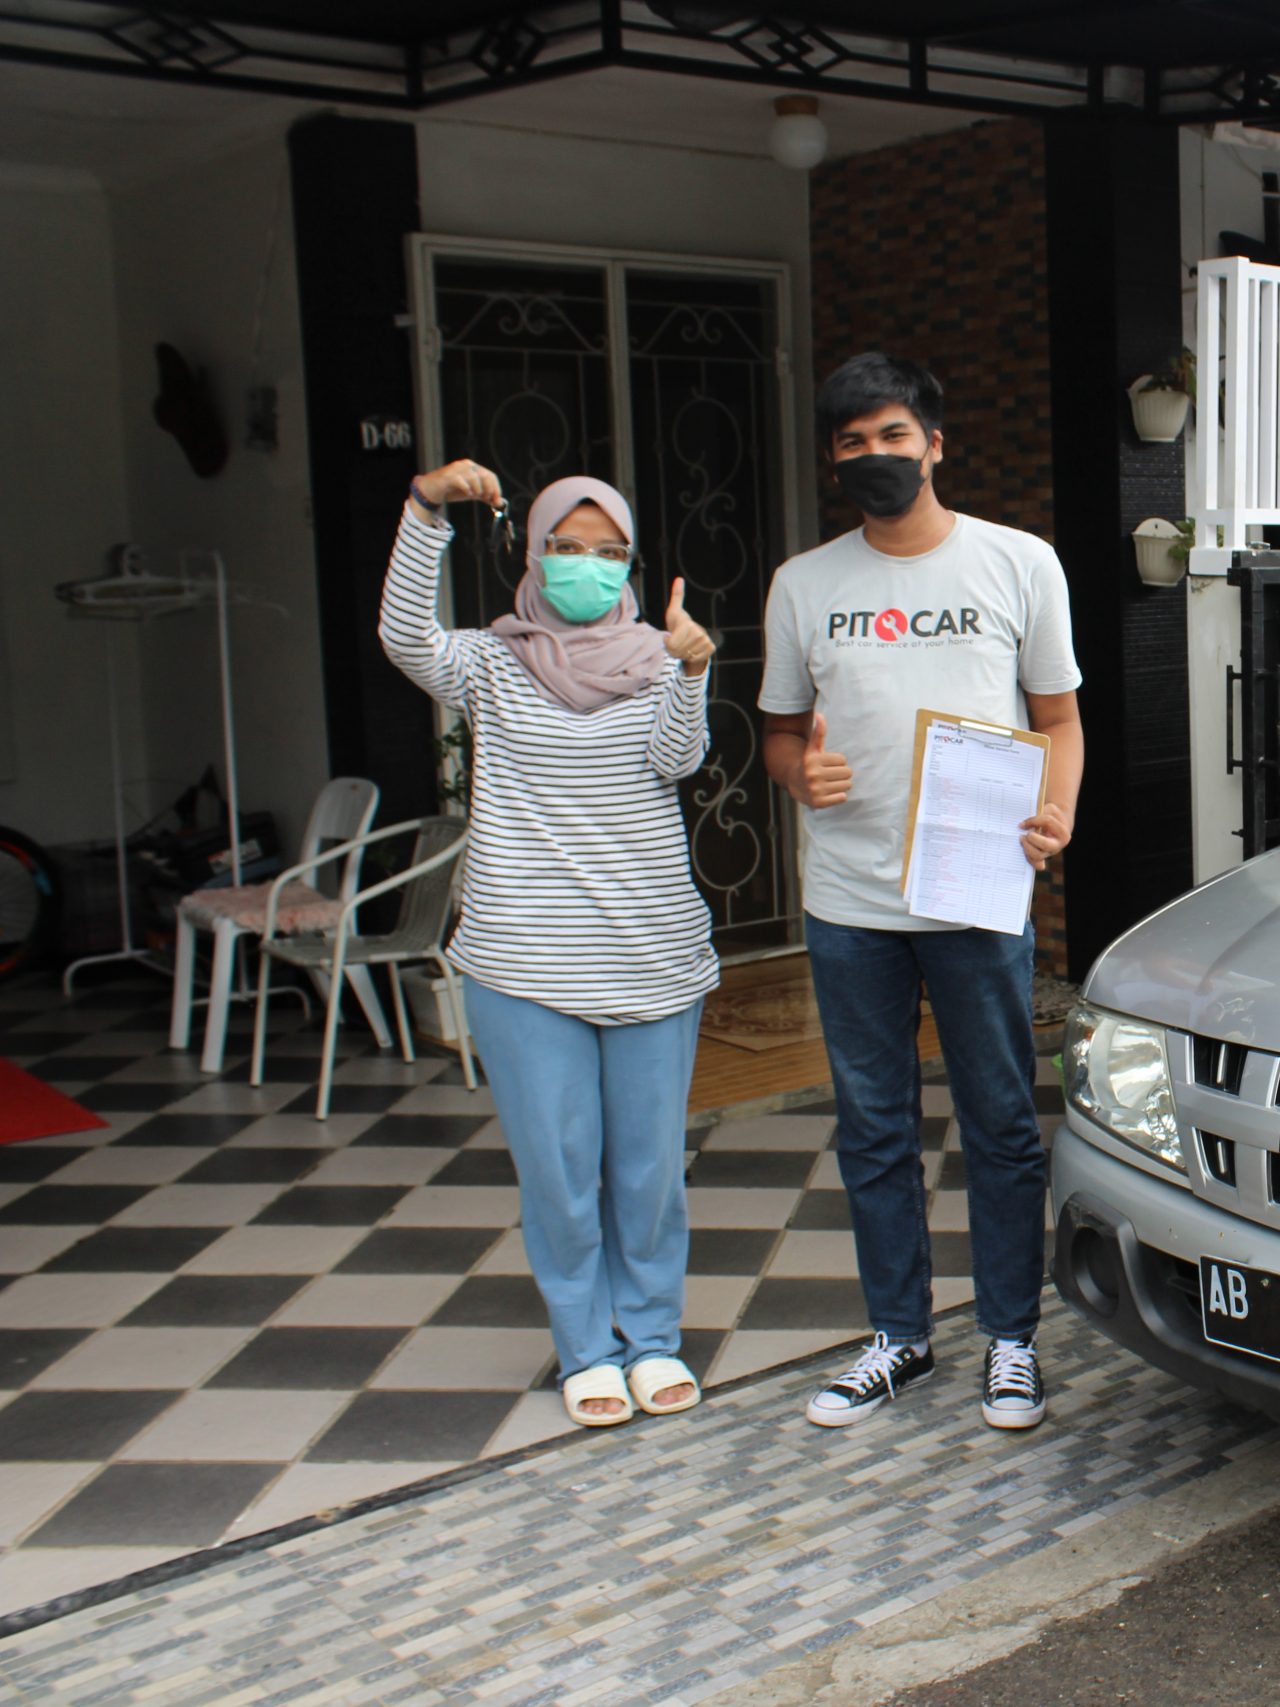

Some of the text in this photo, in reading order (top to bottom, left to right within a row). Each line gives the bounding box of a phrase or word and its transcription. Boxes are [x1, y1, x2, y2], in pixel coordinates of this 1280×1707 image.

[835, 636, 974, 649] Best car service at your home
[1209, 1264, 1249, 1320] AB
